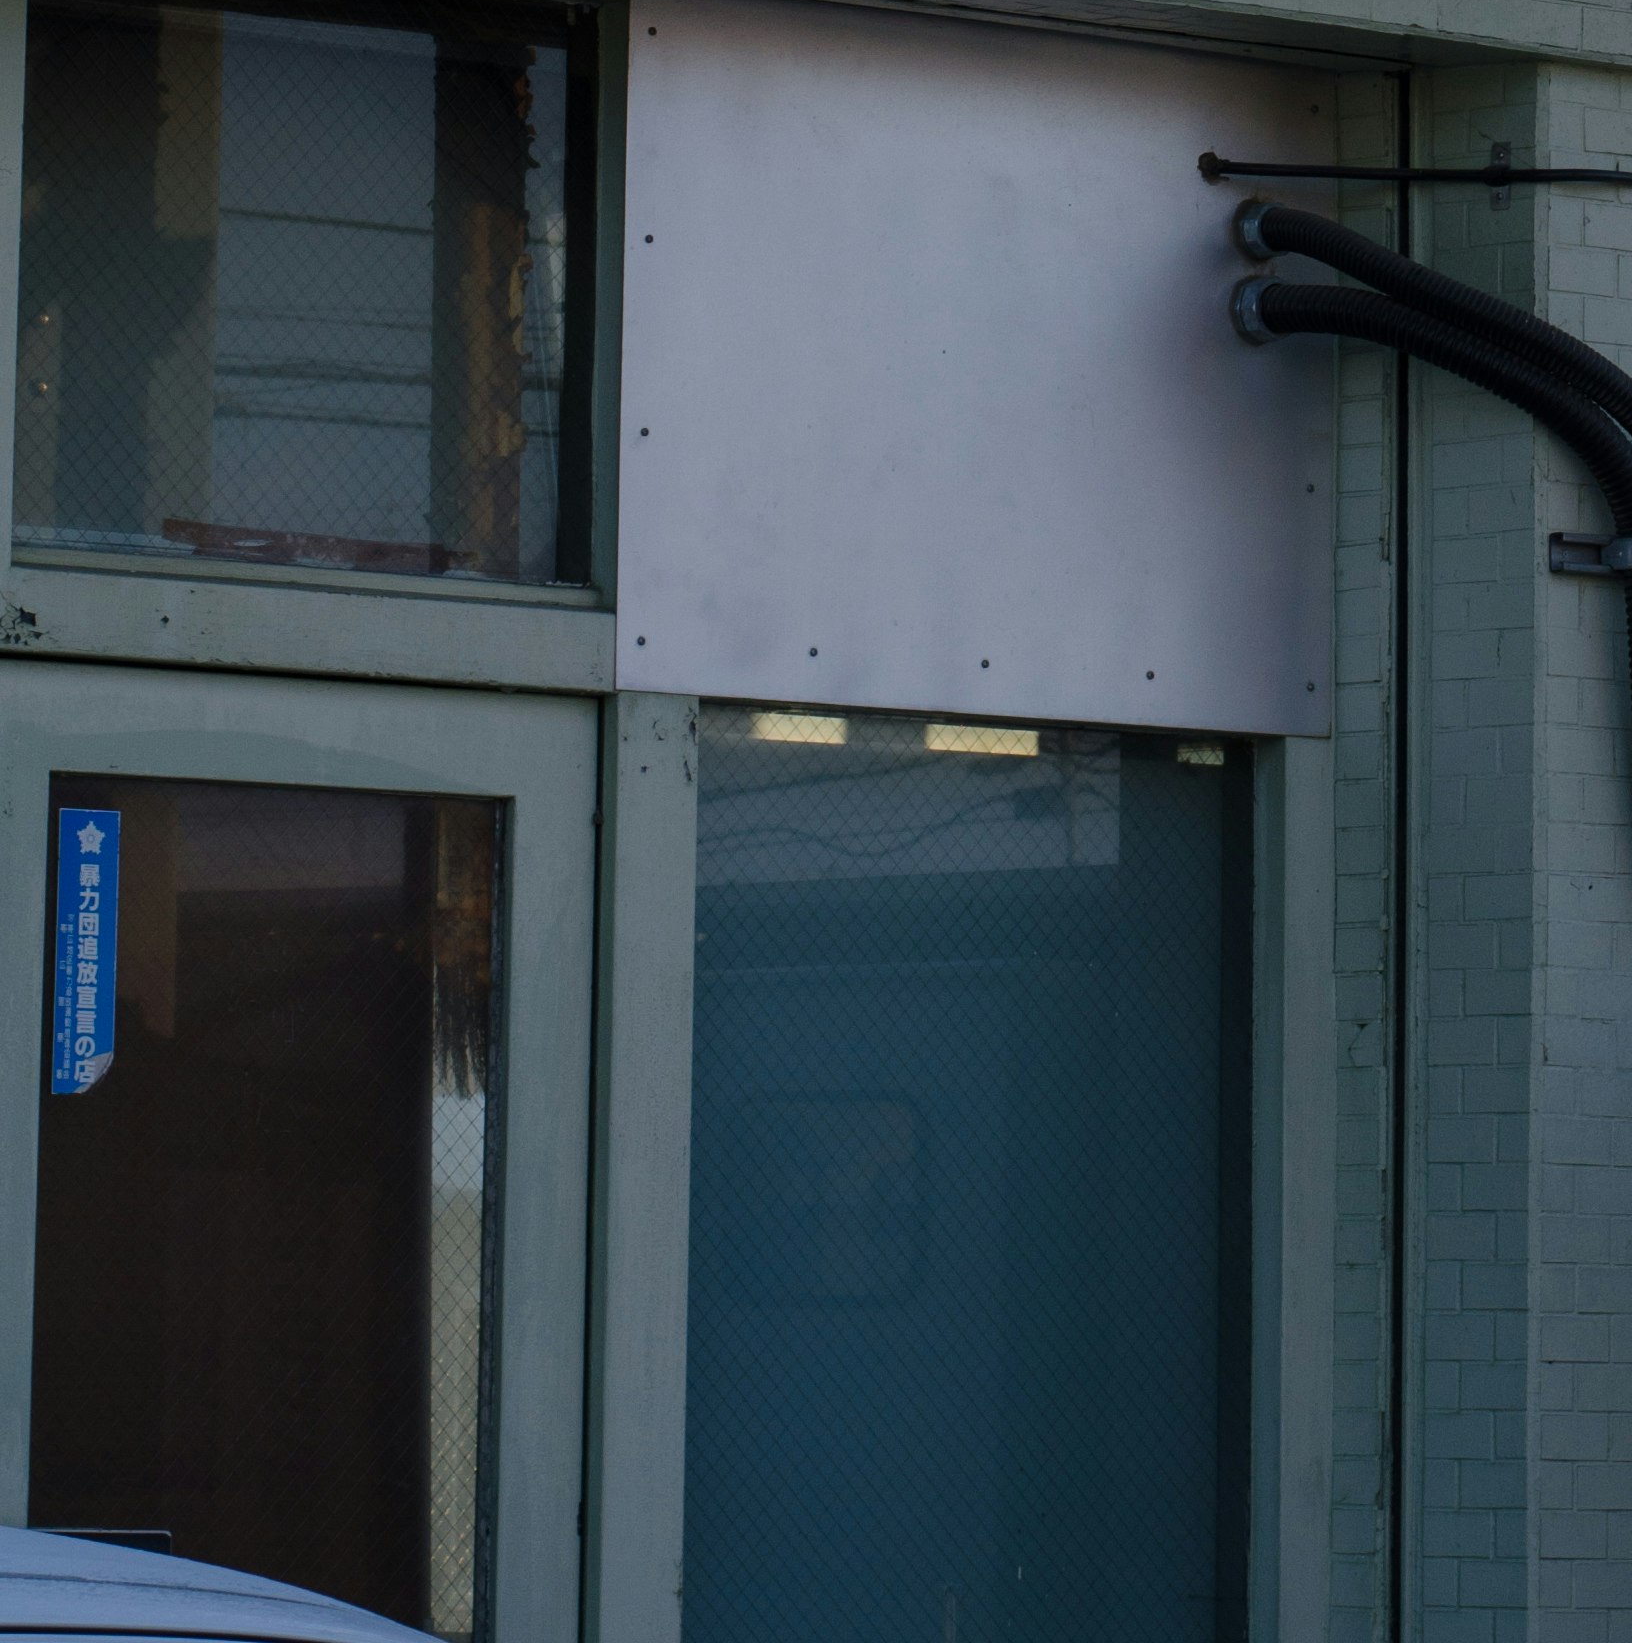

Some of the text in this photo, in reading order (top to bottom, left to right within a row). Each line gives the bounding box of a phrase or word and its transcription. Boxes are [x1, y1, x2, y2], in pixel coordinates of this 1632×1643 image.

[74, 864, 101, 1083] 暴力団追放宣言の店
